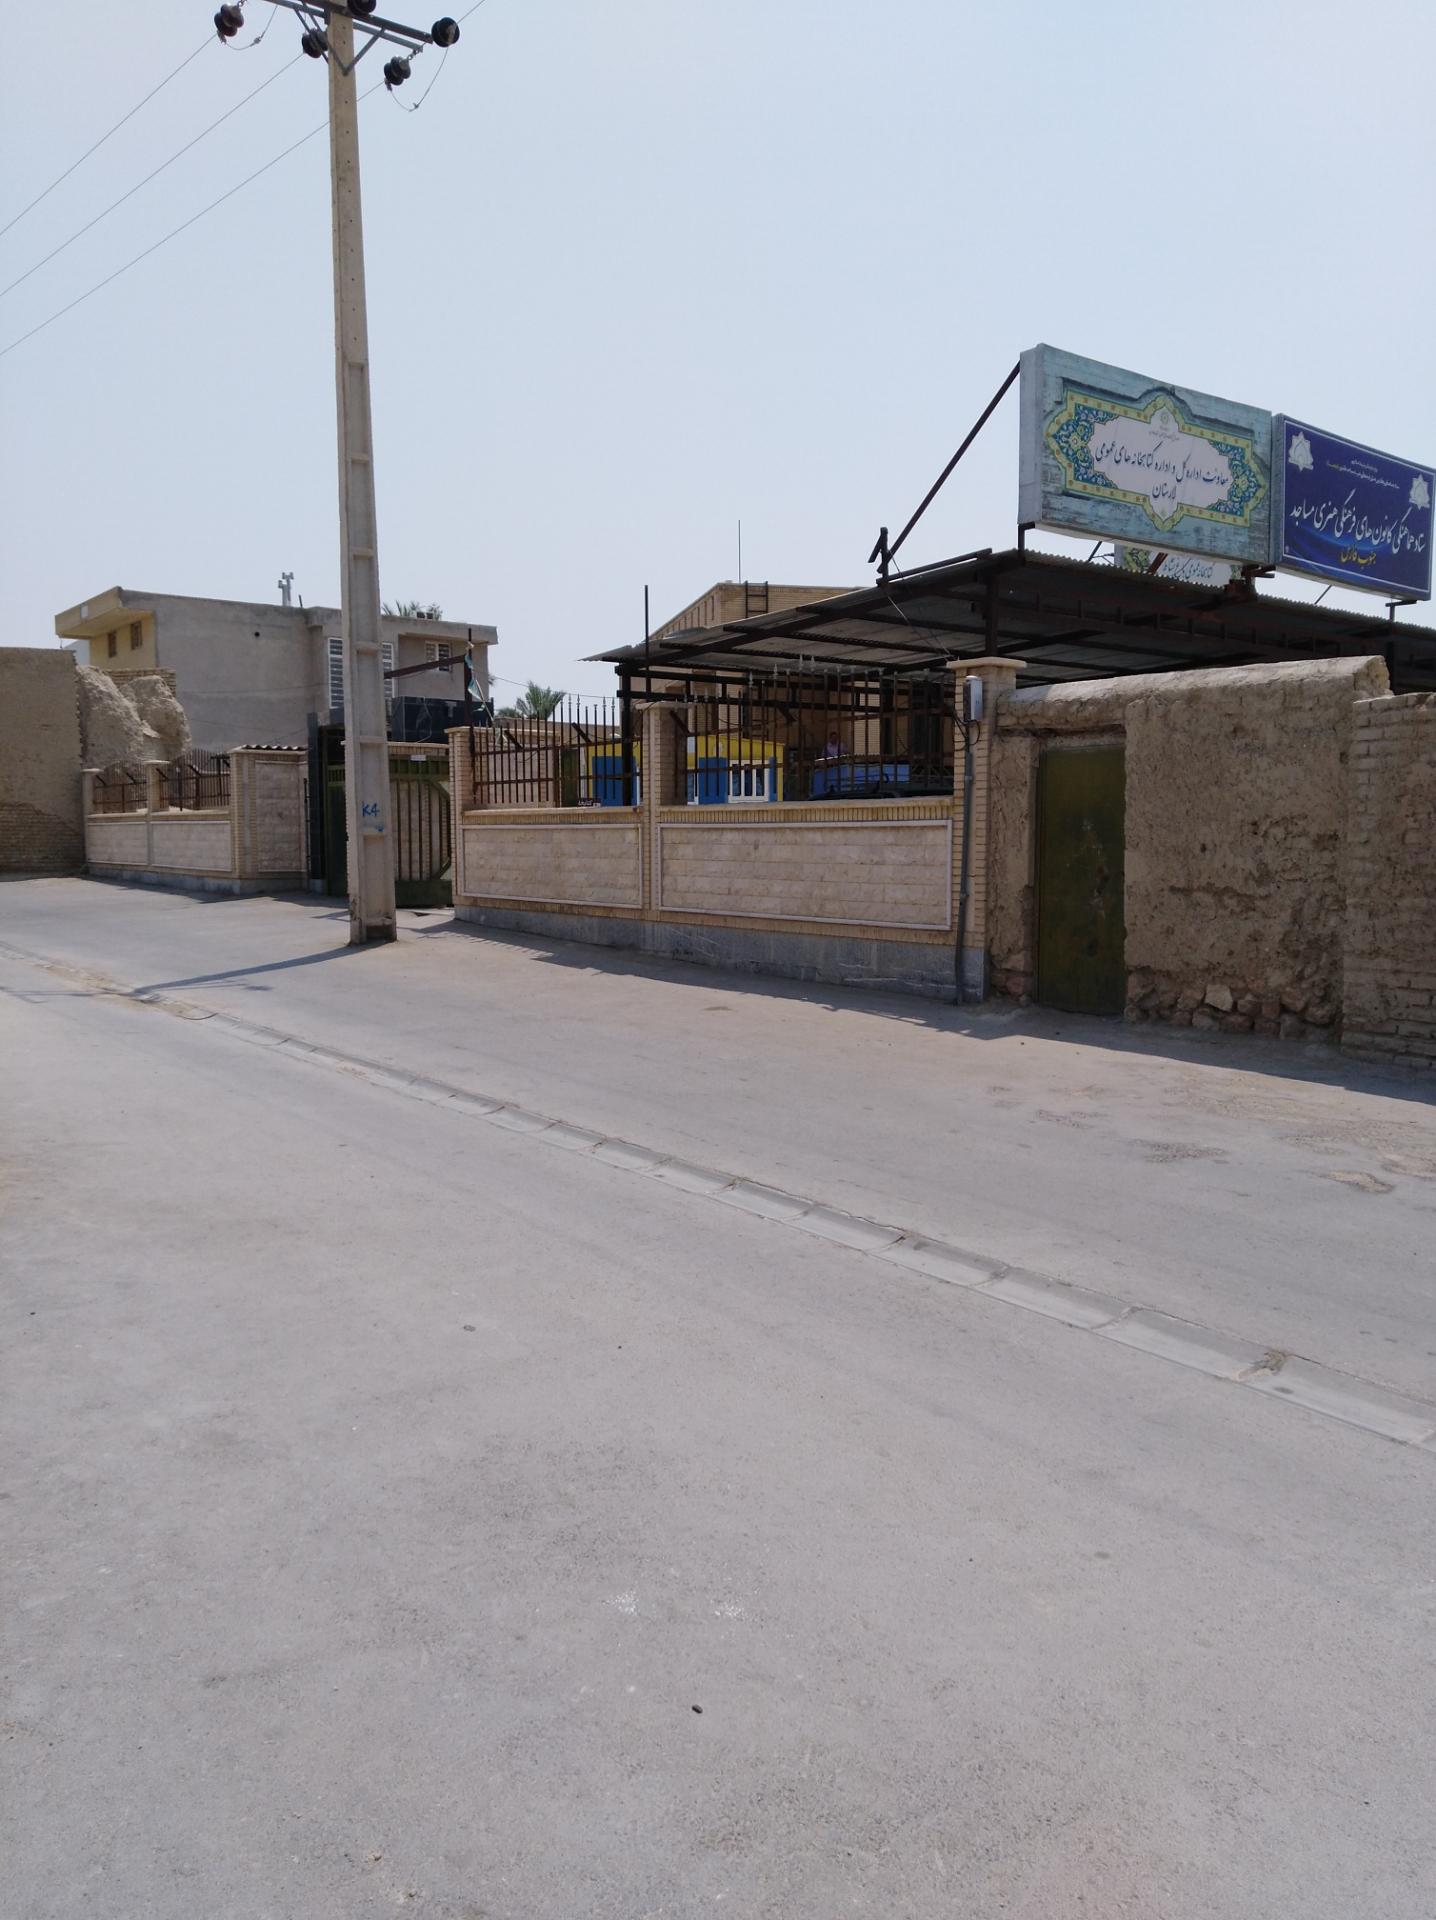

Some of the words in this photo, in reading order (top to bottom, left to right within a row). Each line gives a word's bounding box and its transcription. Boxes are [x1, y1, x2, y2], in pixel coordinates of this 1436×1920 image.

[1095, 441, 1116, 462] عمومی
[1114, 446, 1130, 464] های
[1131, 440, 1163, 468] کتابخانه
[1154, 460, 1171, 473] اداره
[1171, 464, 1176, 475] و
[1176, 452, 1191, 482] کل
[1186, 468, 1201, 480] اداره
[1202, 469, 1228, 486] معاونت
[1151, 482, 1177, 500] لارستان
[1289, 499, 1315, 527] مساجد
[1313, 500, 1338, 532] هنری
[1334, 487, 1357, 538] فرهنگی
[1355, 515, 1372, 541] های
[1371, 515, 1399, 546] کانون
[1392, 506, 1414, 554] هماهنگی
[1414, 533, 1426, 553] ستاد
